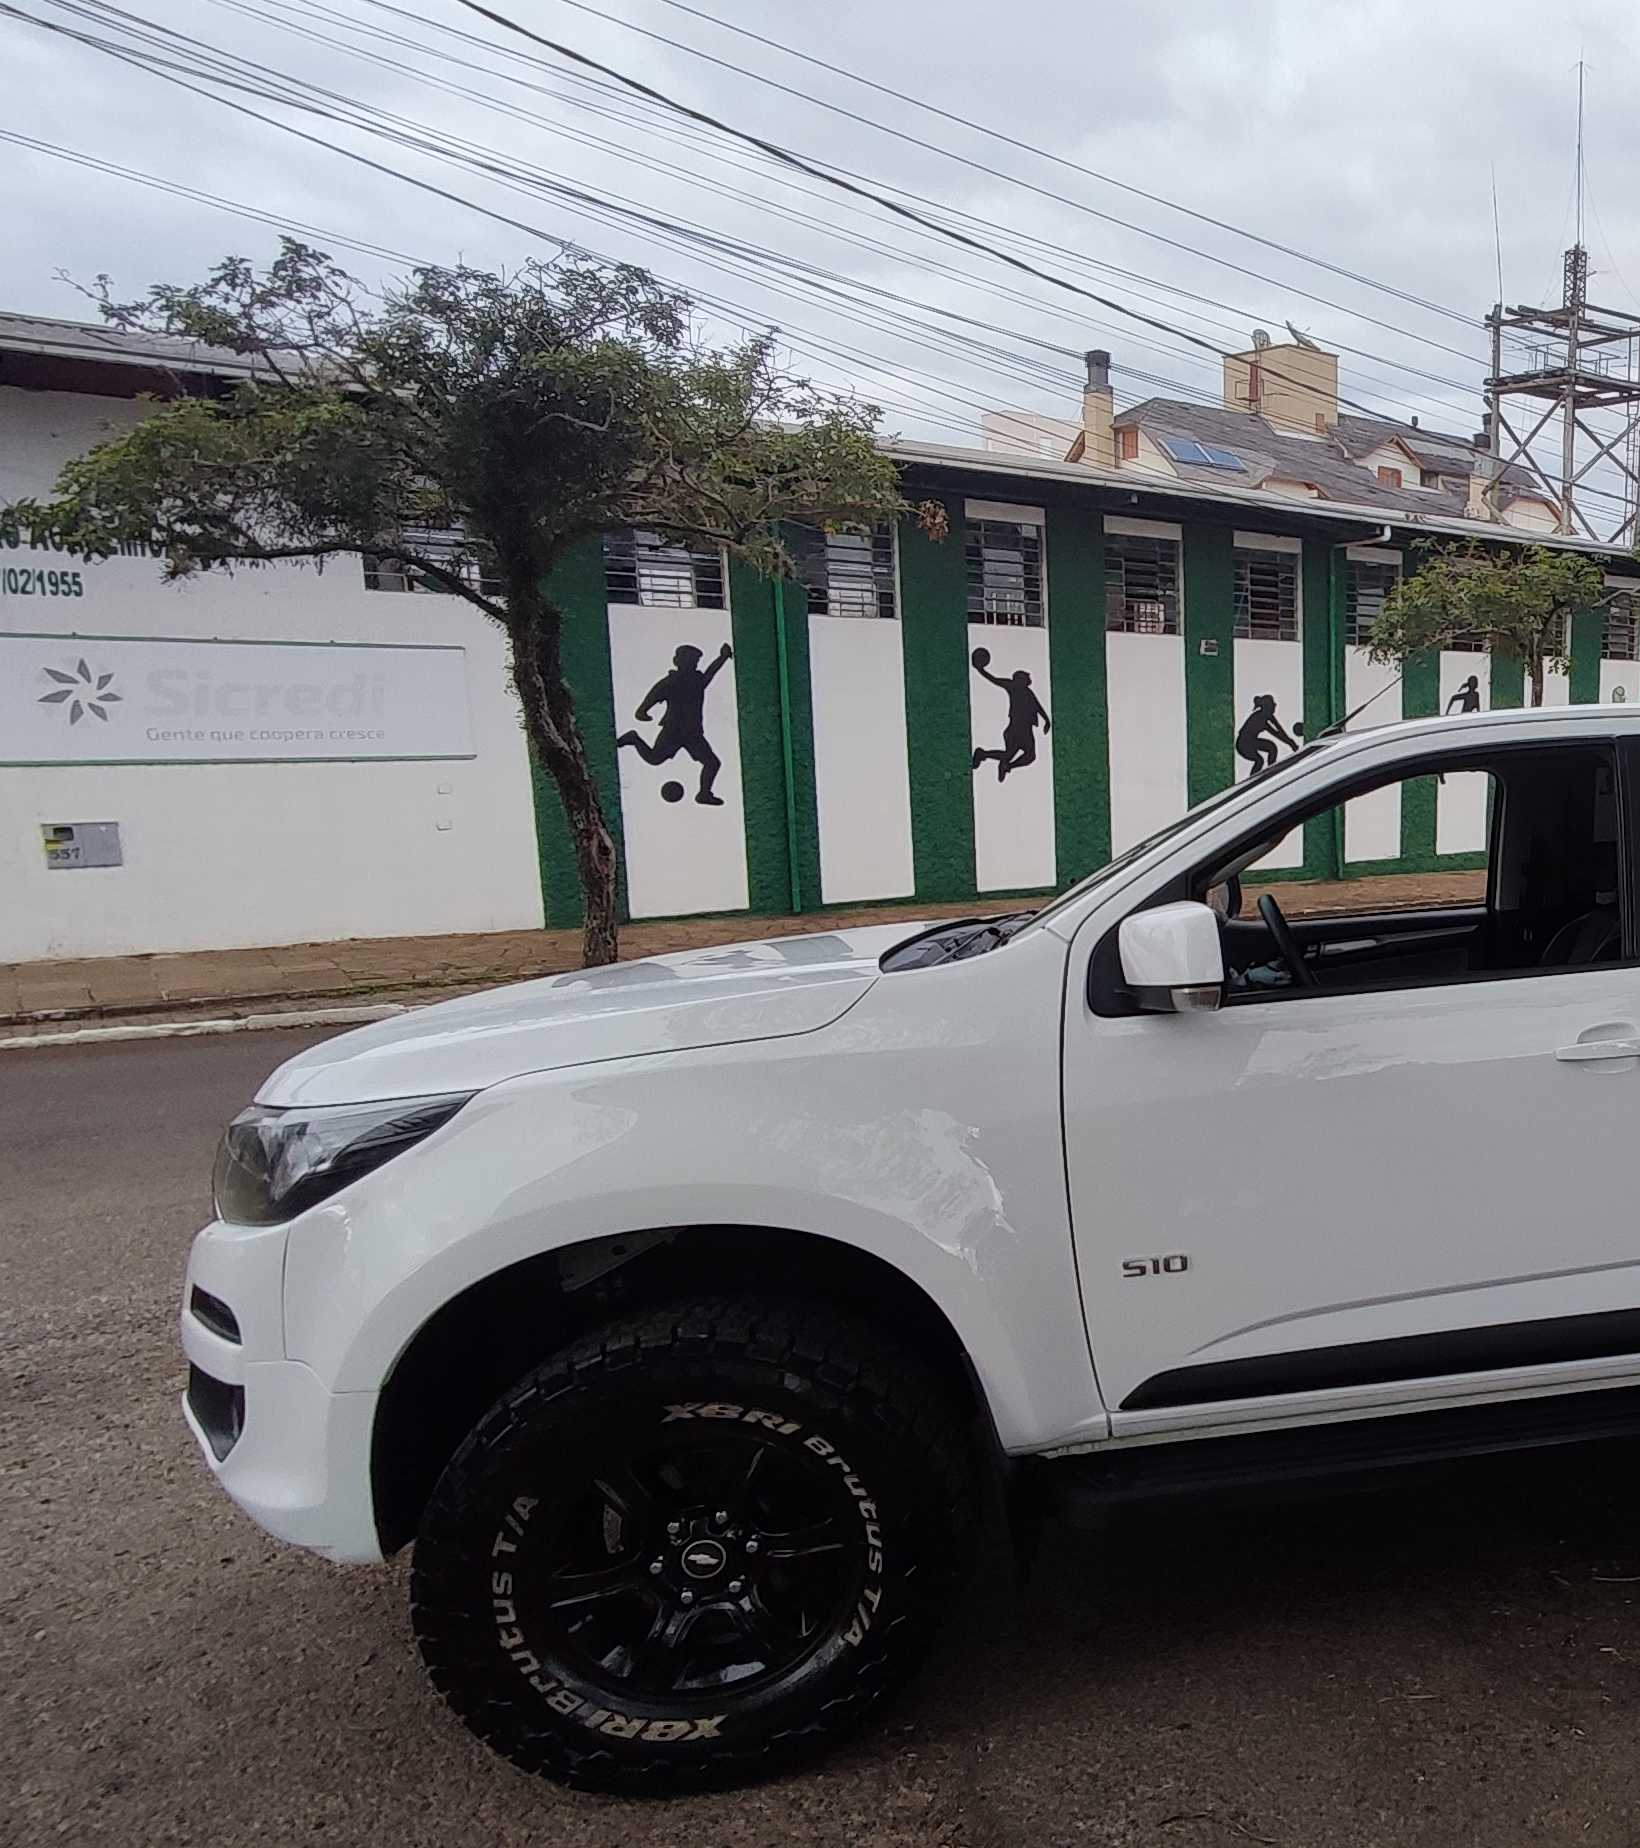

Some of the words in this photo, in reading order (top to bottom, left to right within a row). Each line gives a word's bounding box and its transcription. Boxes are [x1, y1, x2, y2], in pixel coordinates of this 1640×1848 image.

[0, 567, 84, 598] /02/1955
[145, 669, 386, 717] Sicredi
[146, 728, 205, 741] Gente
[1122, 1254, 1188, 1278] S10
[490, 1495, 542, 1558] T/A
[659, 1401, 805, 1436] XBRI
[841, 1584, 883, 1648] T/A
[583, 1708, 729, 1742] XBRI
